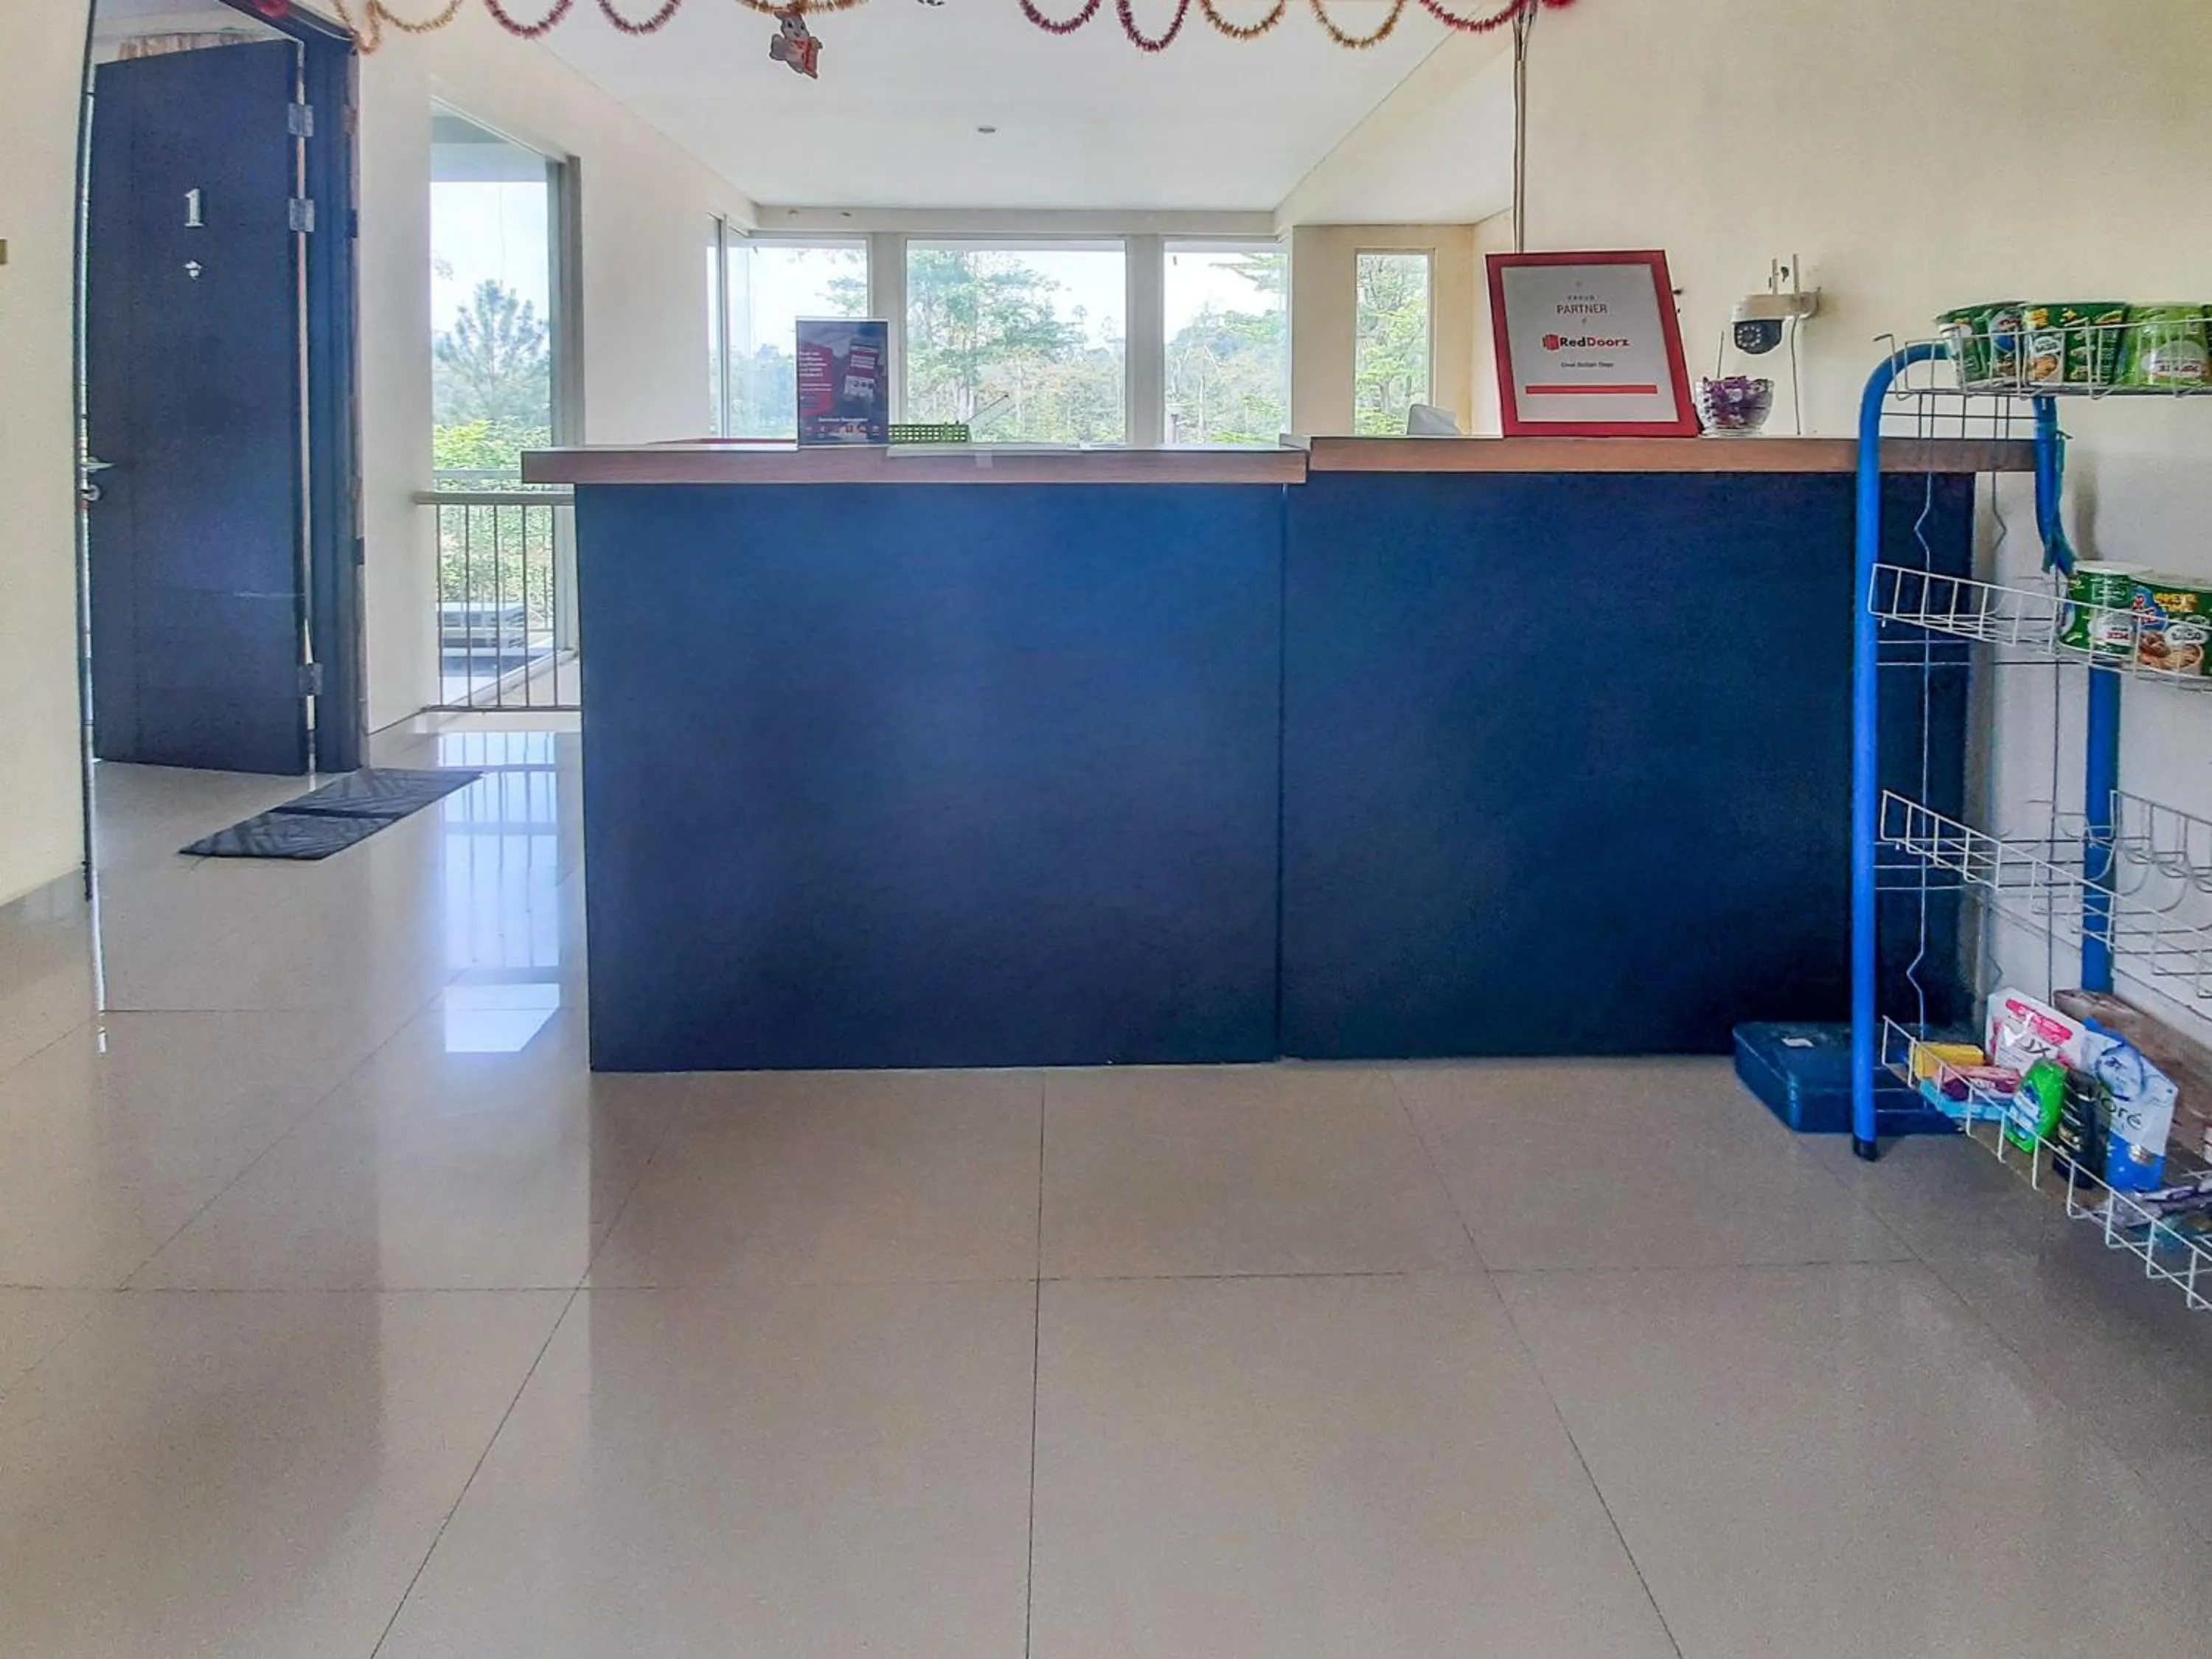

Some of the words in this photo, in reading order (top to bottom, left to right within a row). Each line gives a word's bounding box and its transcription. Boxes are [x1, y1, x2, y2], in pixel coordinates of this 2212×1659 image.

[184, 188, 204, 227] 1
[1557, 303, 1608, 314] PARTNER
[1559, 335, 1630, 347] RedDoorz
